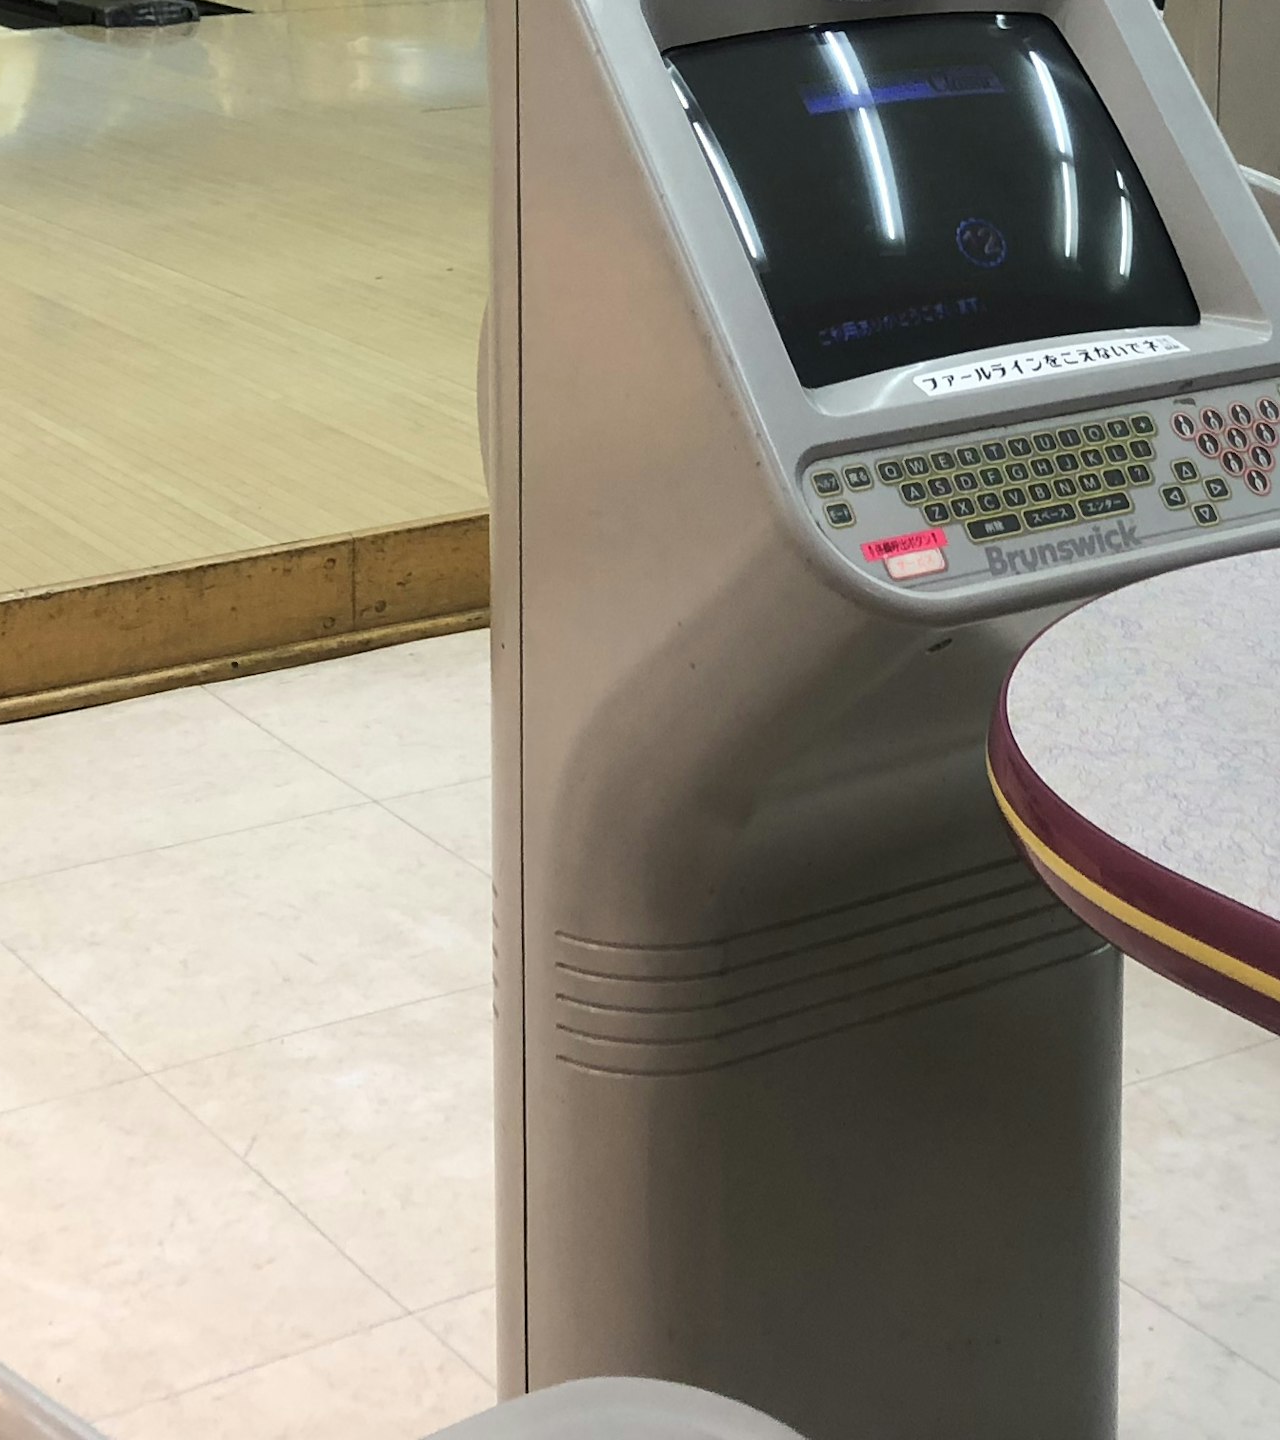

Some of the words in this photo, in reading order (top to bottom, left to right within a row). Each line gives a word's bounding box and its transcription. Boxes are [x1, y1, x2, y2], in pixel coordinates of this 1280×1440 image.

[962, 228, 1001, 256] 12
[964, 450, 975, 462] R
[985, 519, 1142, 576] Brunswick
